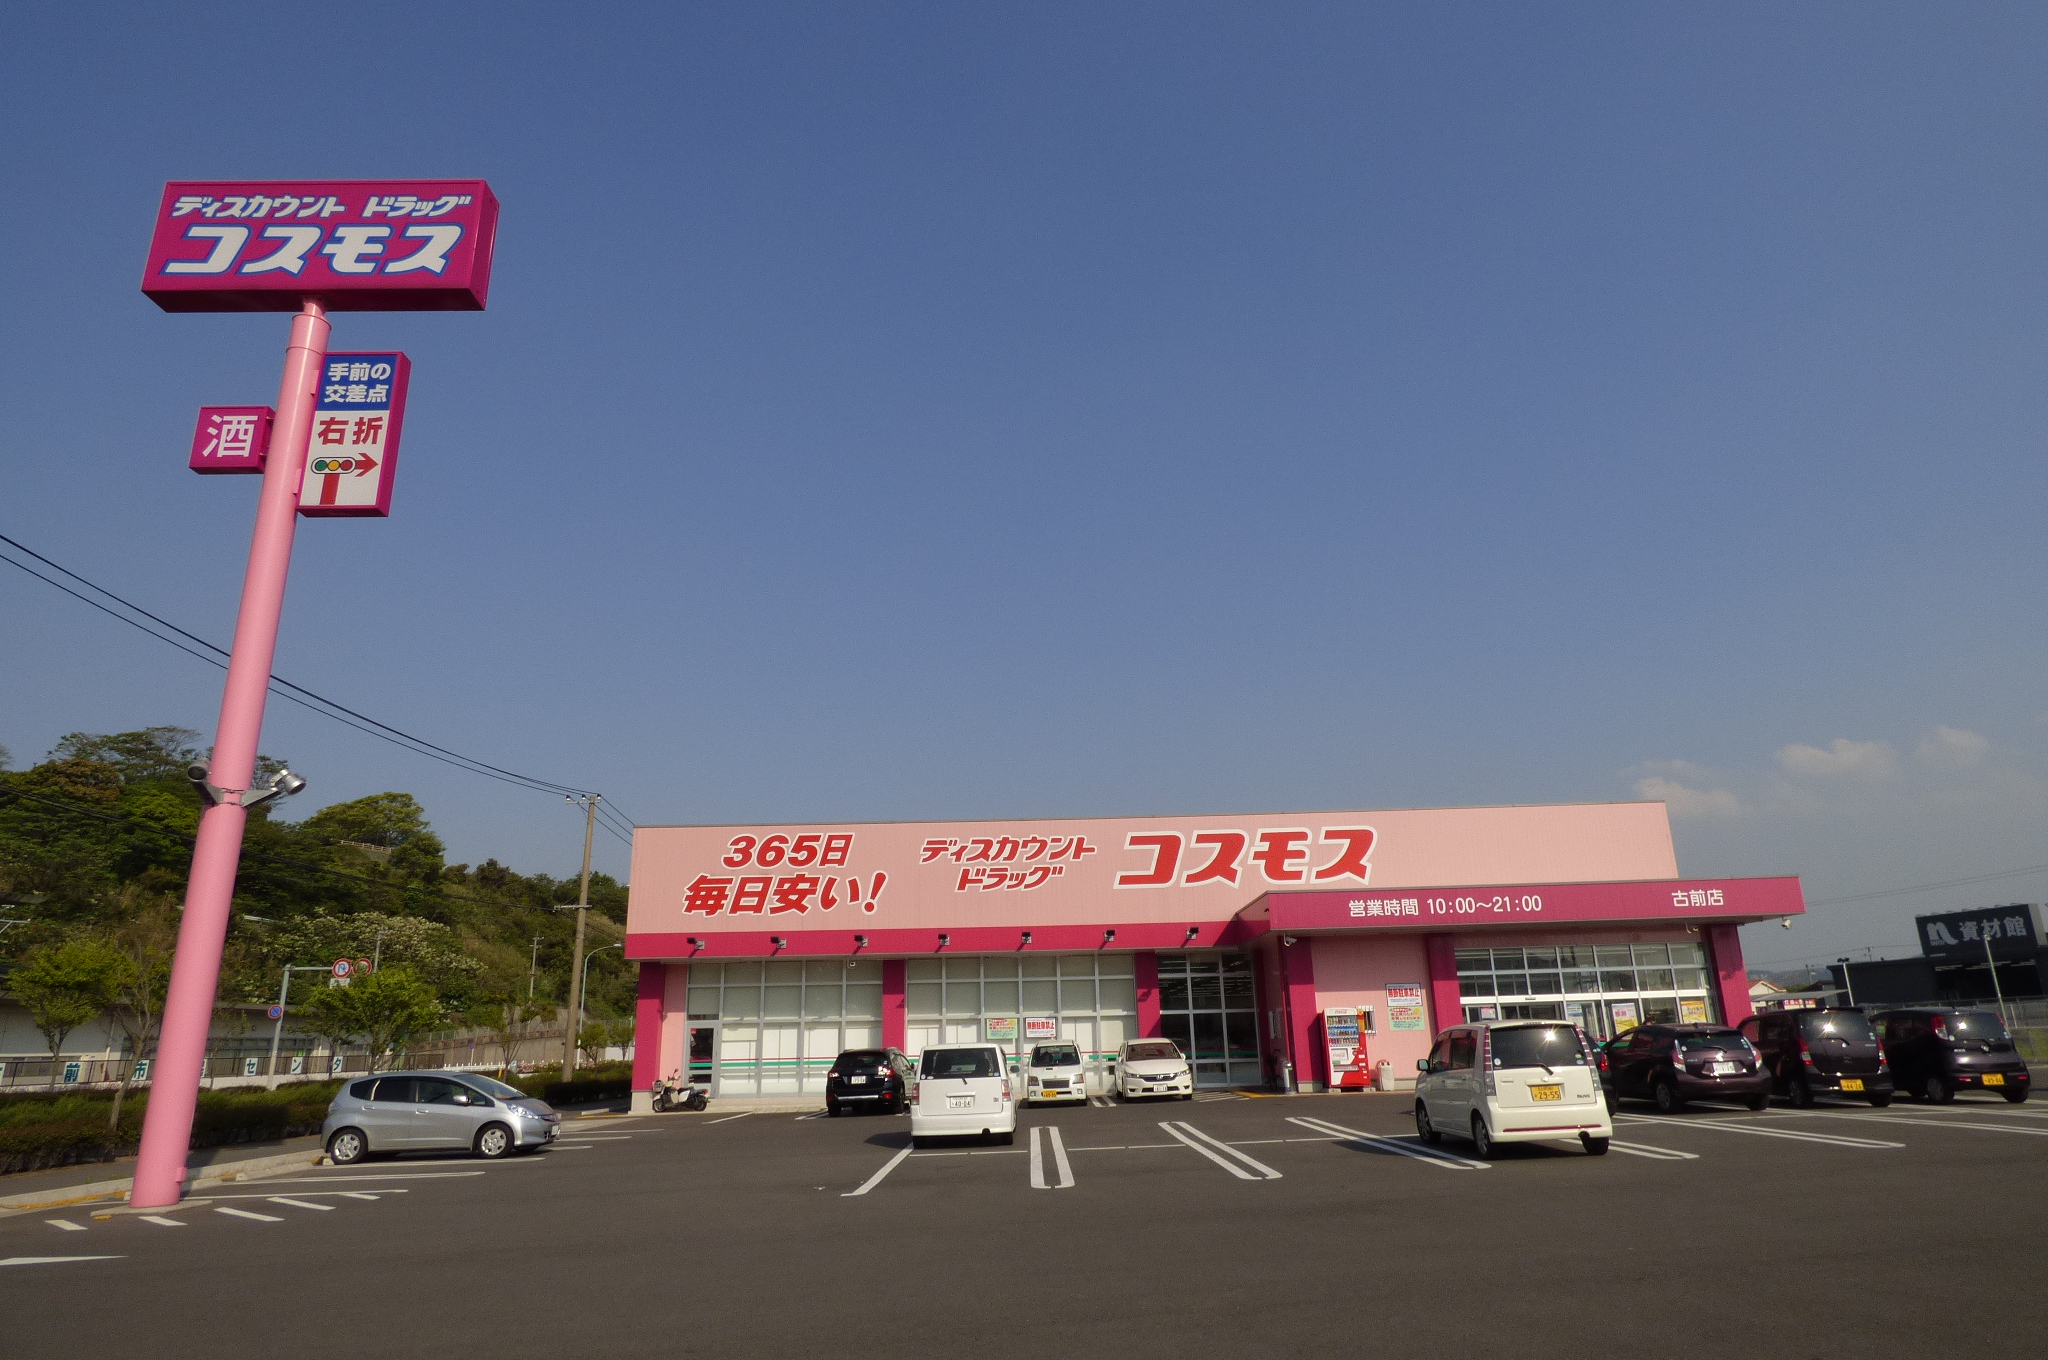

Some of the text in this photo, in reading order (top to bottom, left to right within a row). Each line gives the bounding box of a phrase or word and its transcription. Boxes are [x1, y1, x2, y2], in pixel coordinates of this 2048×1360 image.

[171, 195, 473, 218] ディスカウント ドラッグ
[161, 223, 466, 278] コスモス
[328, 363, 391, 381] 手前の
[324, 384, 389, 403] 交差点
[202, 414, 258, 457] 酒
[318, 417, 383, 445] 右折
[721, 833, 854, 869] 365日
[919, 834, 1098, 864] ディスカウント
[1113, 825, 1378, 889] コスモス
[955, 864, 1065, 893] ドラッグ
[682, 870, 888, 917] 毎日安い!
[1671, 888, 1724, 907] 古前店
[1348, 898, 1420, 918] 営業時間
[1958, 916, 2028, 942] 資材館
